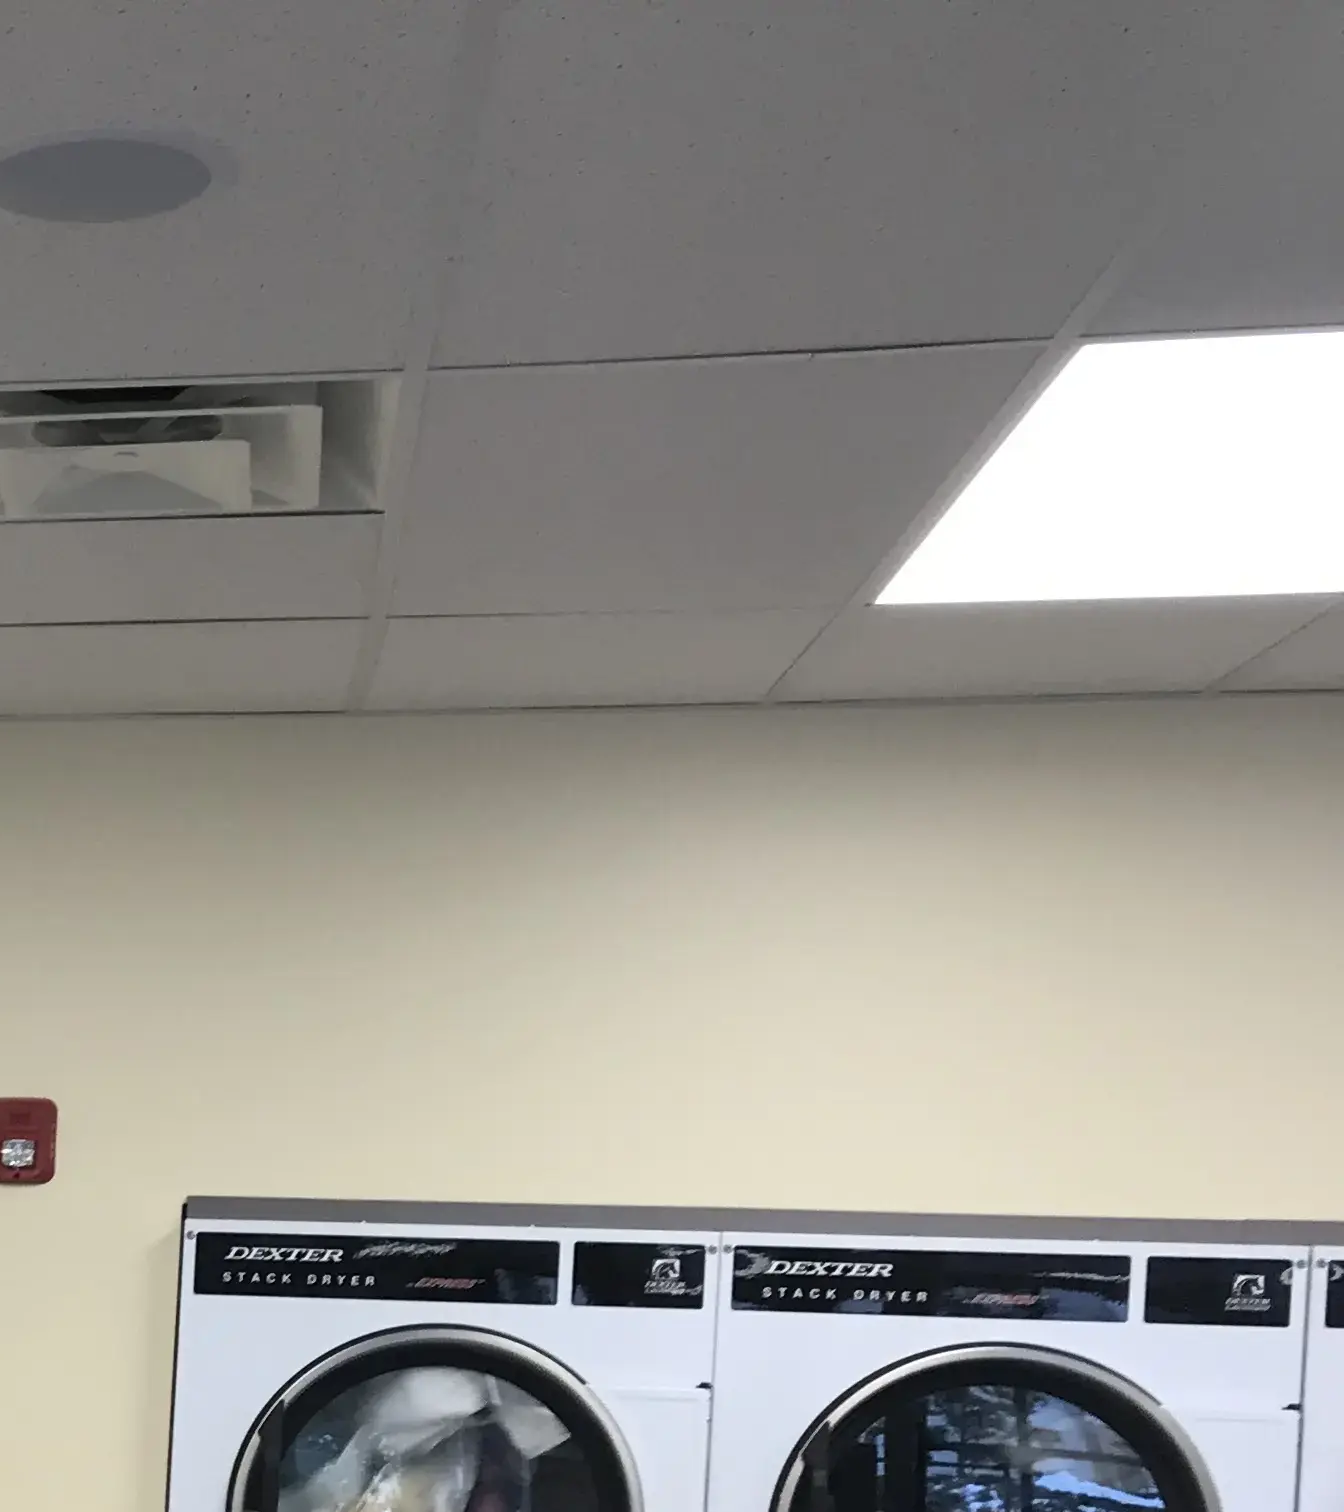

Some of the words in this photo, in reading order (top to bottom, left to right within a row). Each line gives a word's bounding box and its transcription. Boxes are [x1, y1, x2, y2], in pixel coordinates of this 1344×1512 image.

[224, 1246, 344, 1263] DEXTER
[765, 1259, 894, 1278] DEXTER
[222, 1271, 292, 1285] STACK
[306, 1273, 375, 1287] DRYER
[762, 1286, 837, 1301] STACK
[853, 1289, 928, 1304] DRYER
